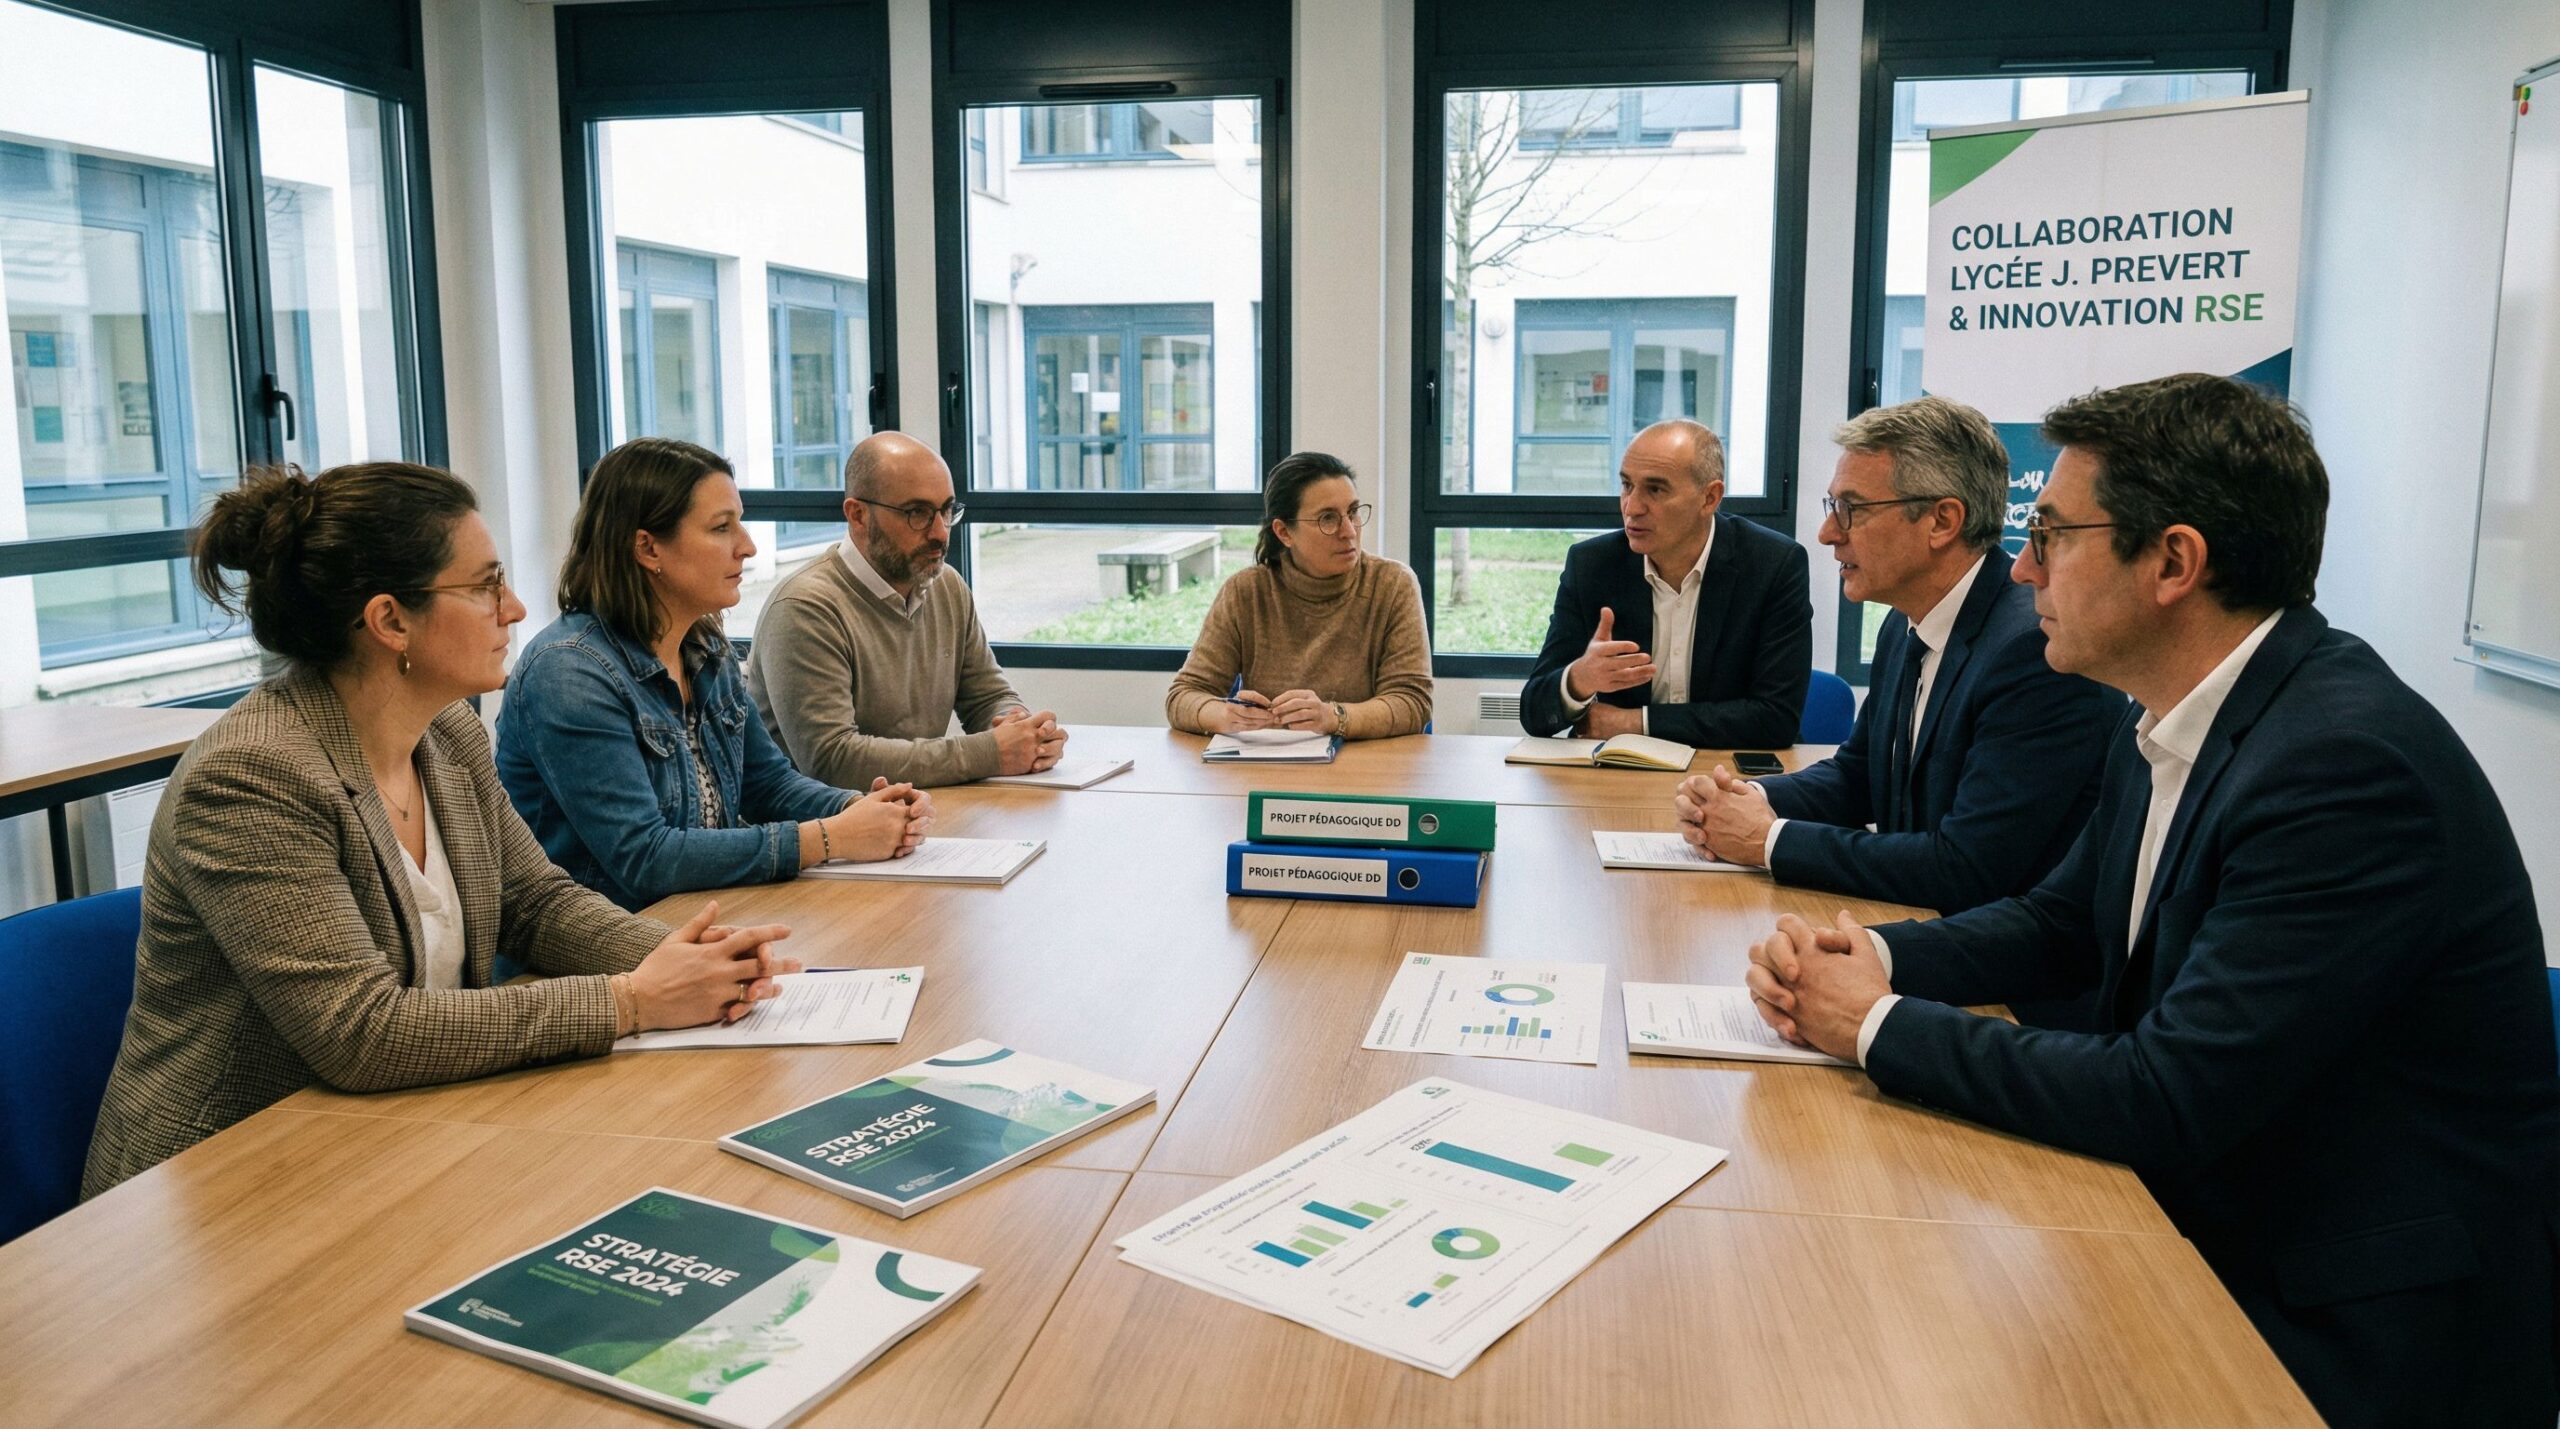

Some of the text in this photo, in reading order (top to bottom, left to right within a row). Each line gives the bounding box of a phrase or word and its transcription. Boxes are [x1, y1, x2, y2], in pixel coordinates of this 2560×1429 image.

[1952, 207, 2233, 251] COLLABORATION
[1950, 250, 2250, 291] LYCÉE J. PREVERT
[1949, 293, 2265, 331] & INNOVATION RSE
[1270, 812, 1401, 828] PROJET PÉDAGOGIQUE DD
[1248, 866, 1381, 883] PROJET PÉDAGOGIQUE DD
[805, 1103, 937, 1159] STRATÉGIE
[826, 1141, 882, 1167] RSE
[875, 1119, 937, 1148] 2024
[554, 1248, 621, 1275] RSE
[610, 1265, 689, 1297] 2024
[583, 1233, 741, 1287] STRATÉGIE
